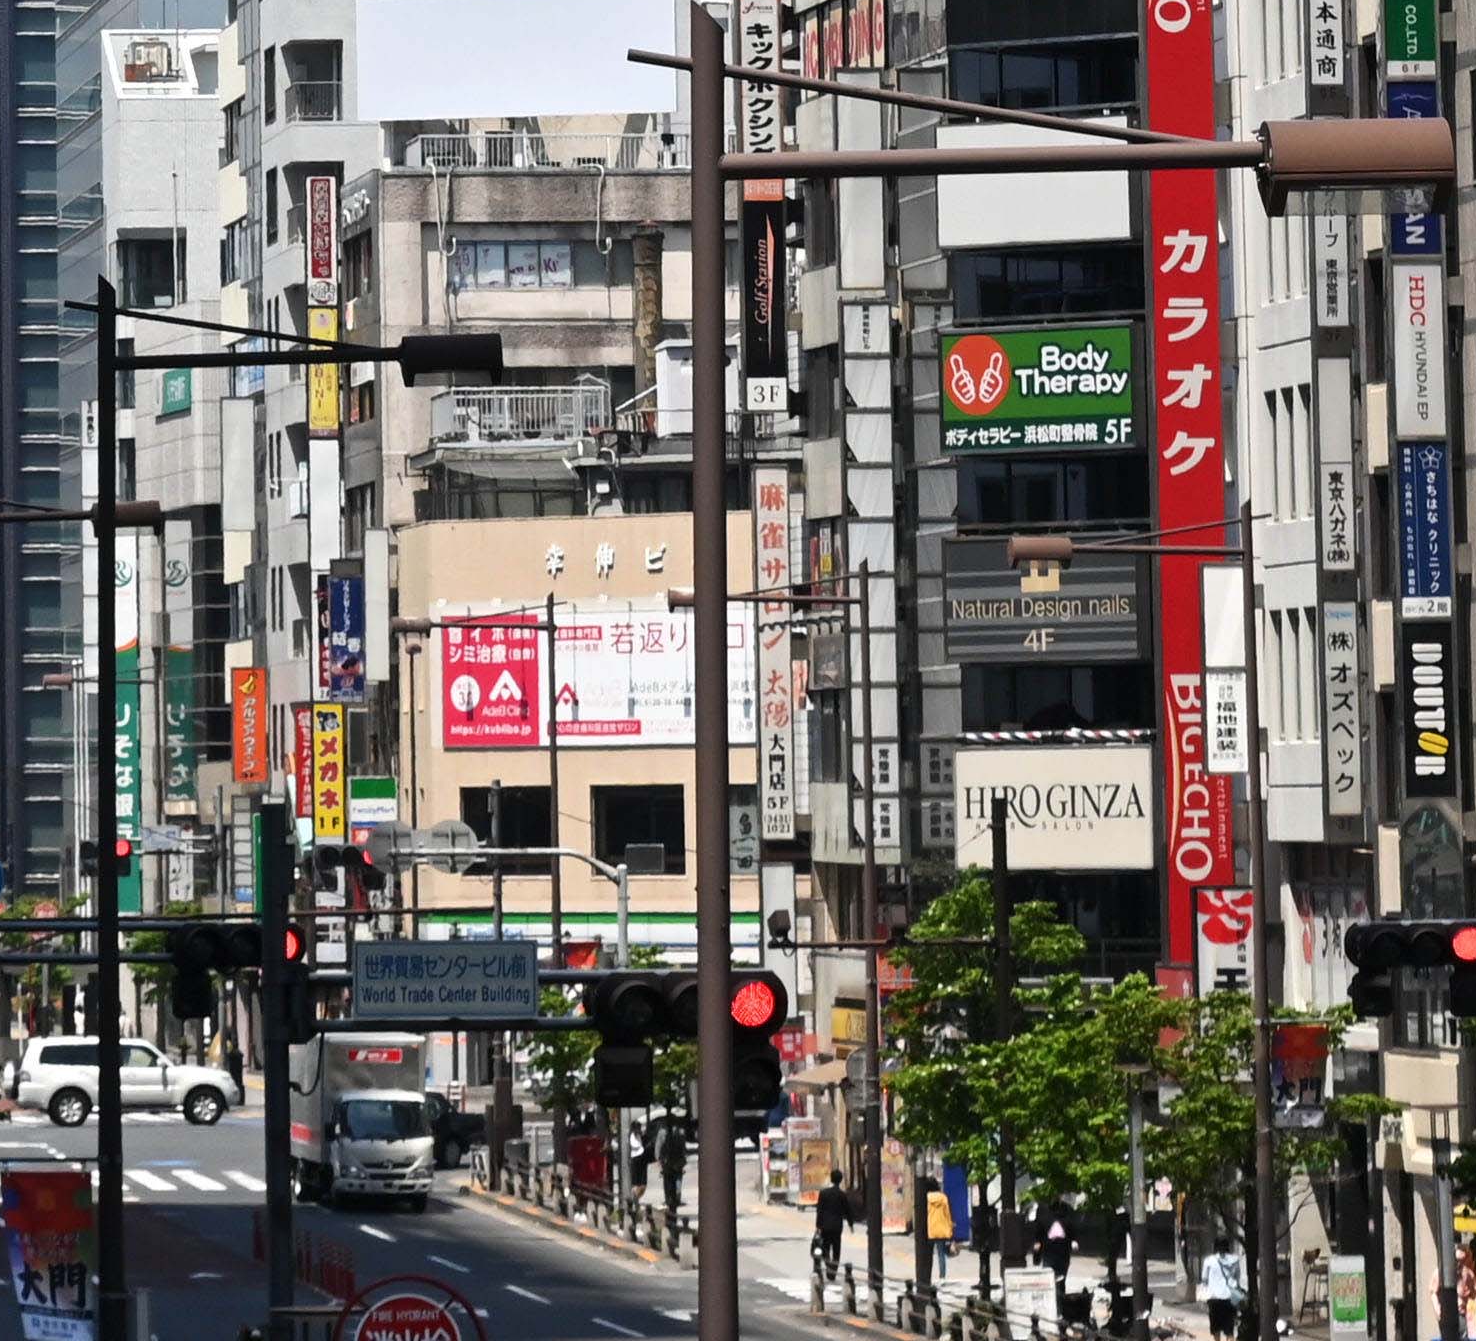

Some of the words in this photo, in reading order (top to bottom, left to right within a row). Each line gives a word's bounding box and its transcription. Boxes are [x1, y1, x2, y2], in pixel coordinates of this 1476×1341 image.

[746, 23, 775, 153] キックボクシン
[754, 293, 769, 325] Golf
[1409, 276, 1426, 326] HDC
[1040, 343, 1109, 373] Body
[1159, 228, 1217, 477] カラオケ
[1415, 331, 1428, 400] HYUNDAI
[754, 385, 780, 403] 3F
[1014, 368, 1128, 396] Therapy
[945, 427, 1022, 447] ボディセラピー
[1024, 423, 1098, 445] 浜松町整骨院
[1104, 418, 1132, 445] 5F
[1327, 471, 1350, 563] 東京ハガネ(株)
[545, 543, 667, 580] 幸伸ビ
[759, 484, 786, 650] 麻雀サロン
[1427, 529, 1442, 593] クリニック
[952, 598, 1014, 620] Natural
[1022, 597, 1083, 621] Design
[1088, 594, 1130, 616] nails
[449, 645, 506, 664] シミ治療
[1023, 628, 1057, 652] 4F
[762, 669, 790, 728] 太陽
[1170, 674, 1202, 754] BIG
[1411, 643, 1450, 776] DOUTOR
[319, 736, 339, 809] メガネ
[766, 733, 786, 790] 大門店
[766, 797, 789, 810] 5F
[1046, 782, 1146, 819] GINZA
[1176, 764, 1213, 882] ECHO
[364, 954, 527, 981] 世界貿易センタービル前
[361, 986, 397, 1004] World
[401, 986, 435, 1004] Trade
[438, 985, 478, 1004] Center
[482, 985, 531, 1006] Building
[17, 1263, 88, 1309] 大門
[372, 1310, 393, 1322] FIRE
[395, 1309, 441, 1322] HYDRANT
